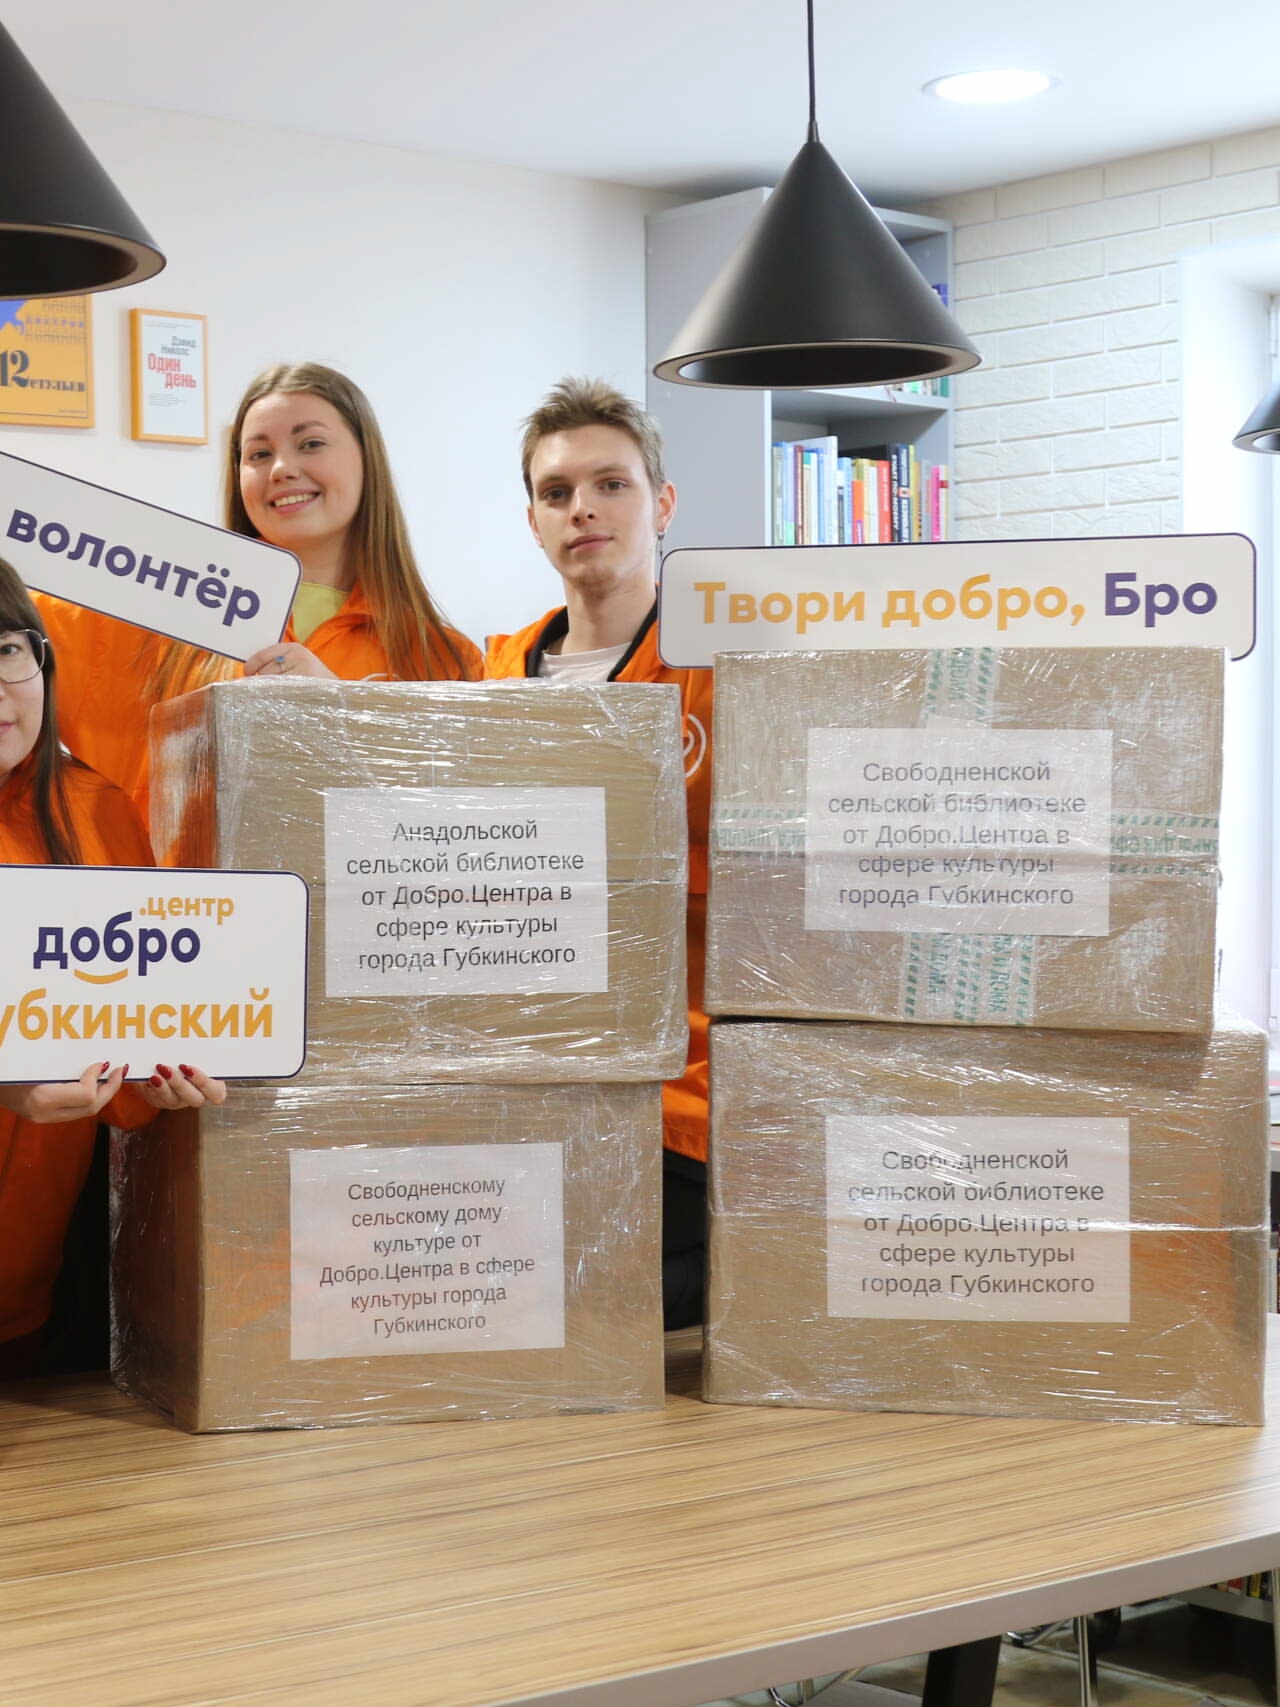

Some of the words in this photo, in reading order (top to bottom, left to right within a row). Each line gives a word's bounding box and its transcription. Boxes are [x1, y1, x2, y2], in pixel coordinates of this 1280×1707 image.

[148, 353, 182, 373] Один
[165, 372, 197, 390] день
[6, 508, 261, 628] волонтёр
[694, 581, 864, 635] Твори
[882, 574, 1086, 632] добро,
[1105, 572, 1218, 628] Бро
[863, 762, 1050, 785] Свободненской
[828, 794, 936, 813] сельской
[944, 794, 1086, 813] библиотеке
[393, 820, 538, 845] Анадольской
[843, 828, 868, 844] от
[875, 824, 1048, 848] Добро.Центра
[1057, 828, 1070, 844] в
[347, 853, 449, 874] сельской
[456, 852, 585, 872] библиотеке
[858, 856, 935, 877] сфере
[943, 858, 1054, 877] культуры
[362, 890, 386, 906] от
[393, 884, 553, 909] Добро.Центра
[560, 885, 572, 900] в
[839, 889, 920, 908] города
[928, 886, 1074, 907] Губкинского
[139, 896, 235, 925] .центр
[376, 917, 449, 941] сфере
[456, 917, 558, 939] культуры
[33, 911, 201, 976] добро
[359, 952, 436, 973] города
[443, 946, 576, 970] Губкинского
[348, 1178, 506, 1201] Свободненскому
[848, 1182, 956, 1201] сельской
[964, 1182, 1104, 1201] библиотеке
[352, 1208, 450, 1227] сельскому
[454, 1206, 503, 1225] дому
[864, 1216, 888, 1231] от
[897, 1213, 1069, 1236] Добро.Центра
[373, 1235, 456, 1257] культуре
[462, 1233, 483, 1248] от
[880, 1244, 956, 1266] сфере
[964, 1246, 1074, 1267] культуры
[320, 1262, 453, 1287] Добро.Центра
[460, 1263, 470, 1275] в
[476, 1257, 536, 1277] сфере
[862, 1276, 942, 1296] города
[950, 1275, 1095, 1297] Губкинского
[351, 1291, 437, 1313] культуры
[443, 1285, 507, 1305] города
[374, 1314, 486, 1338] Губкинского
